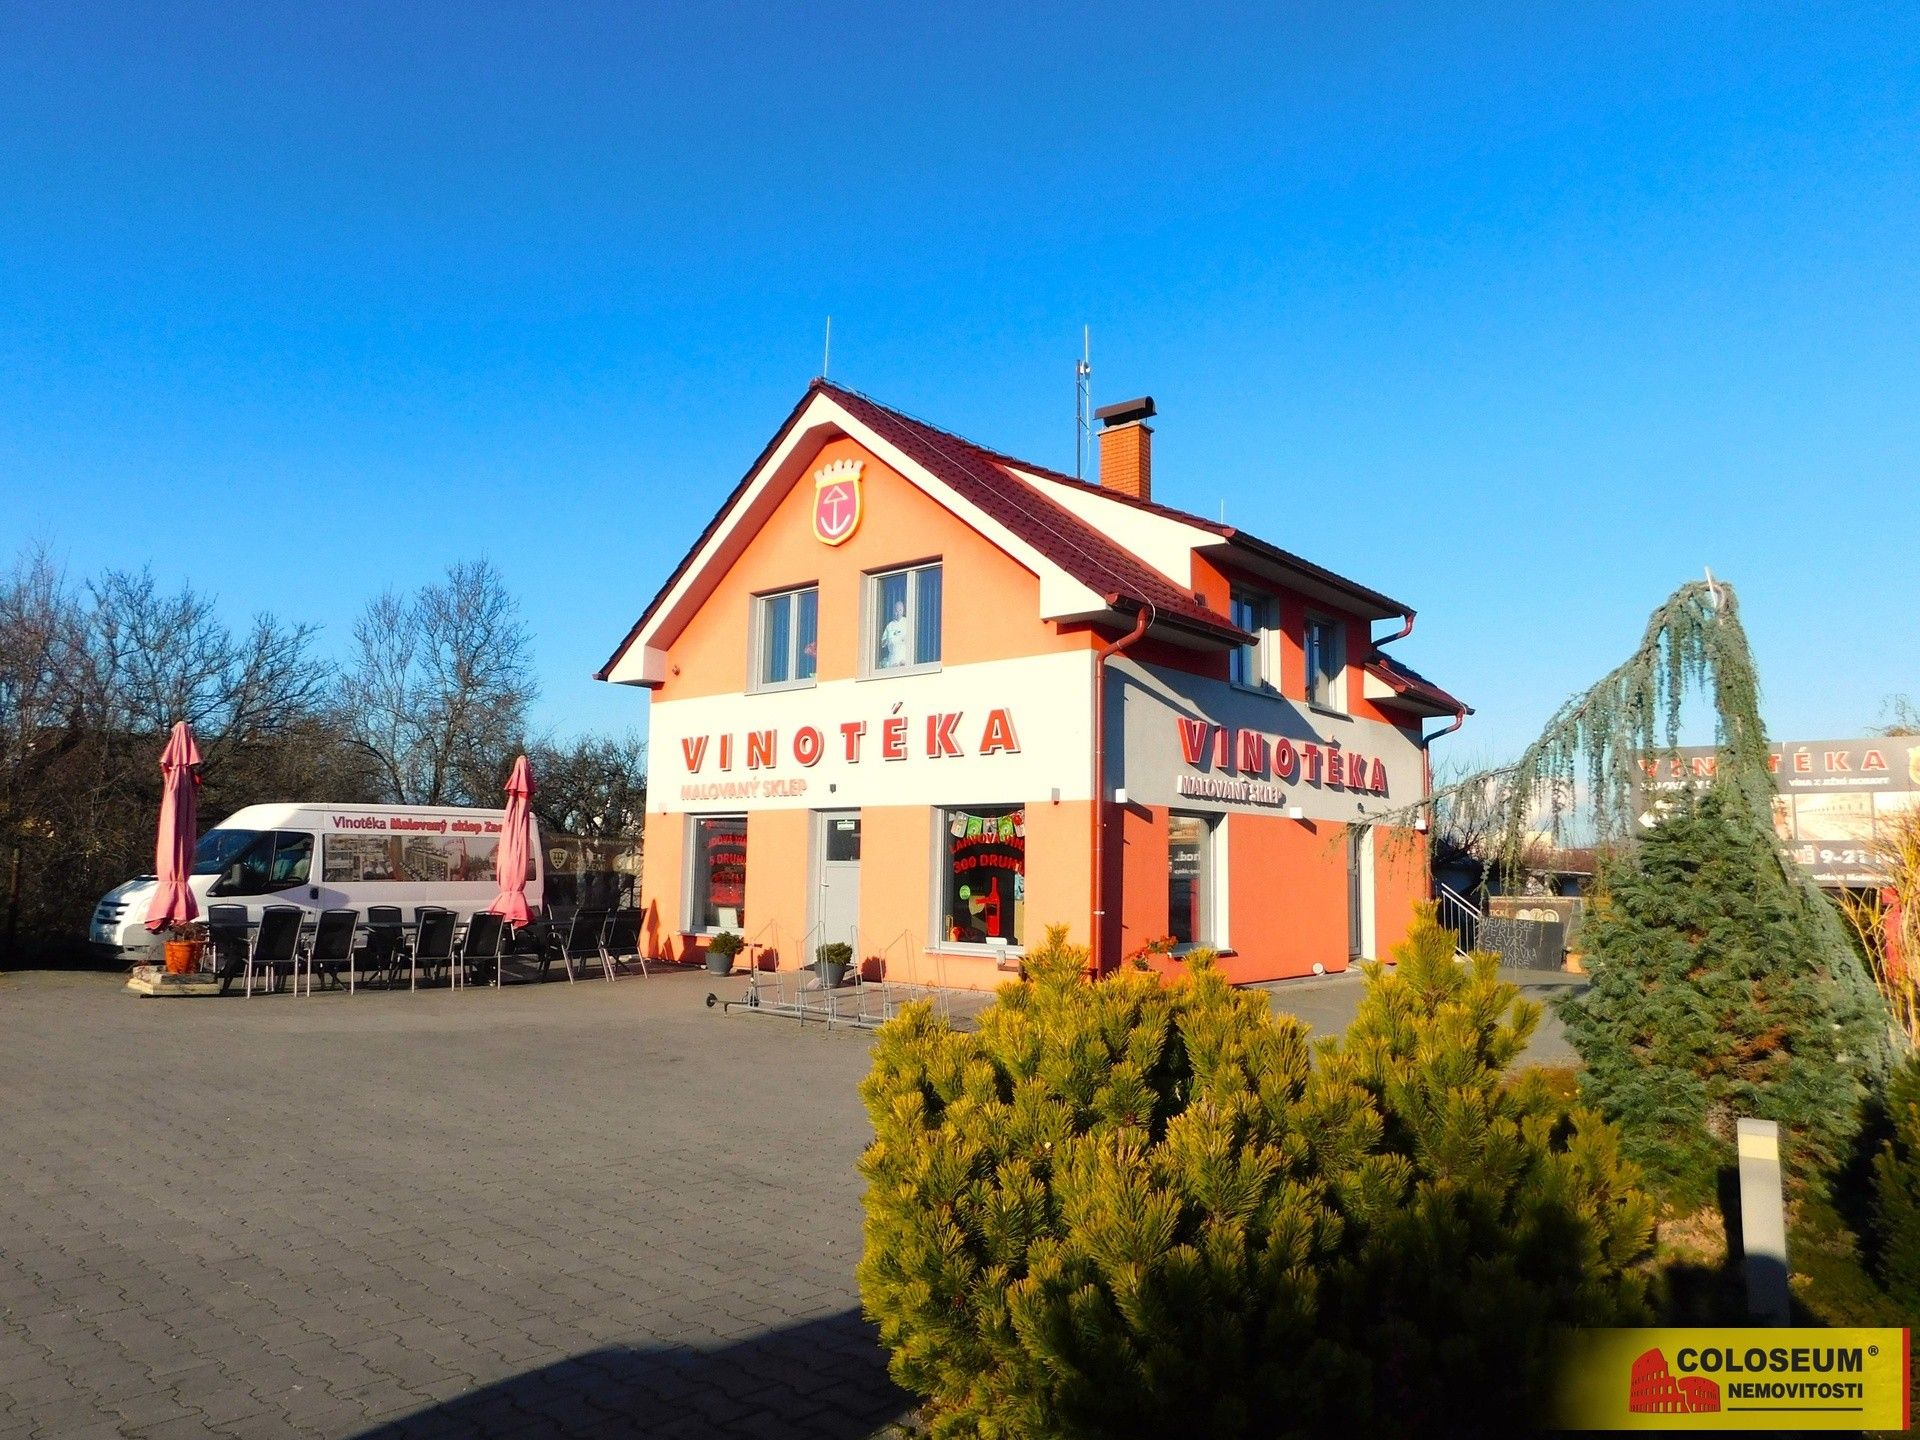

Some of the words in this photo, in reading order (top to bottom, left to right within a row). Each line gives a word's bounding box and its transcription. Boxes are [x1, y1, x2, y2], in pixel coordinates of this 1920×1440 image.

[681, 701, 1021, 773] VINOTÉKA
[1177, 716, 1386, 792] VINOTÉKA
[1637, 746, 1889, 778] VINTÉKA
[681, 776, 760, 800] MALOVANÝ
[763, 779, 807, 798] SKLEP
[1177, 775, 1248, 801] MALOVANÝ
[332, 815, 386, 830] Vinotéka
[390, 818, 447, 834] Malovaný
